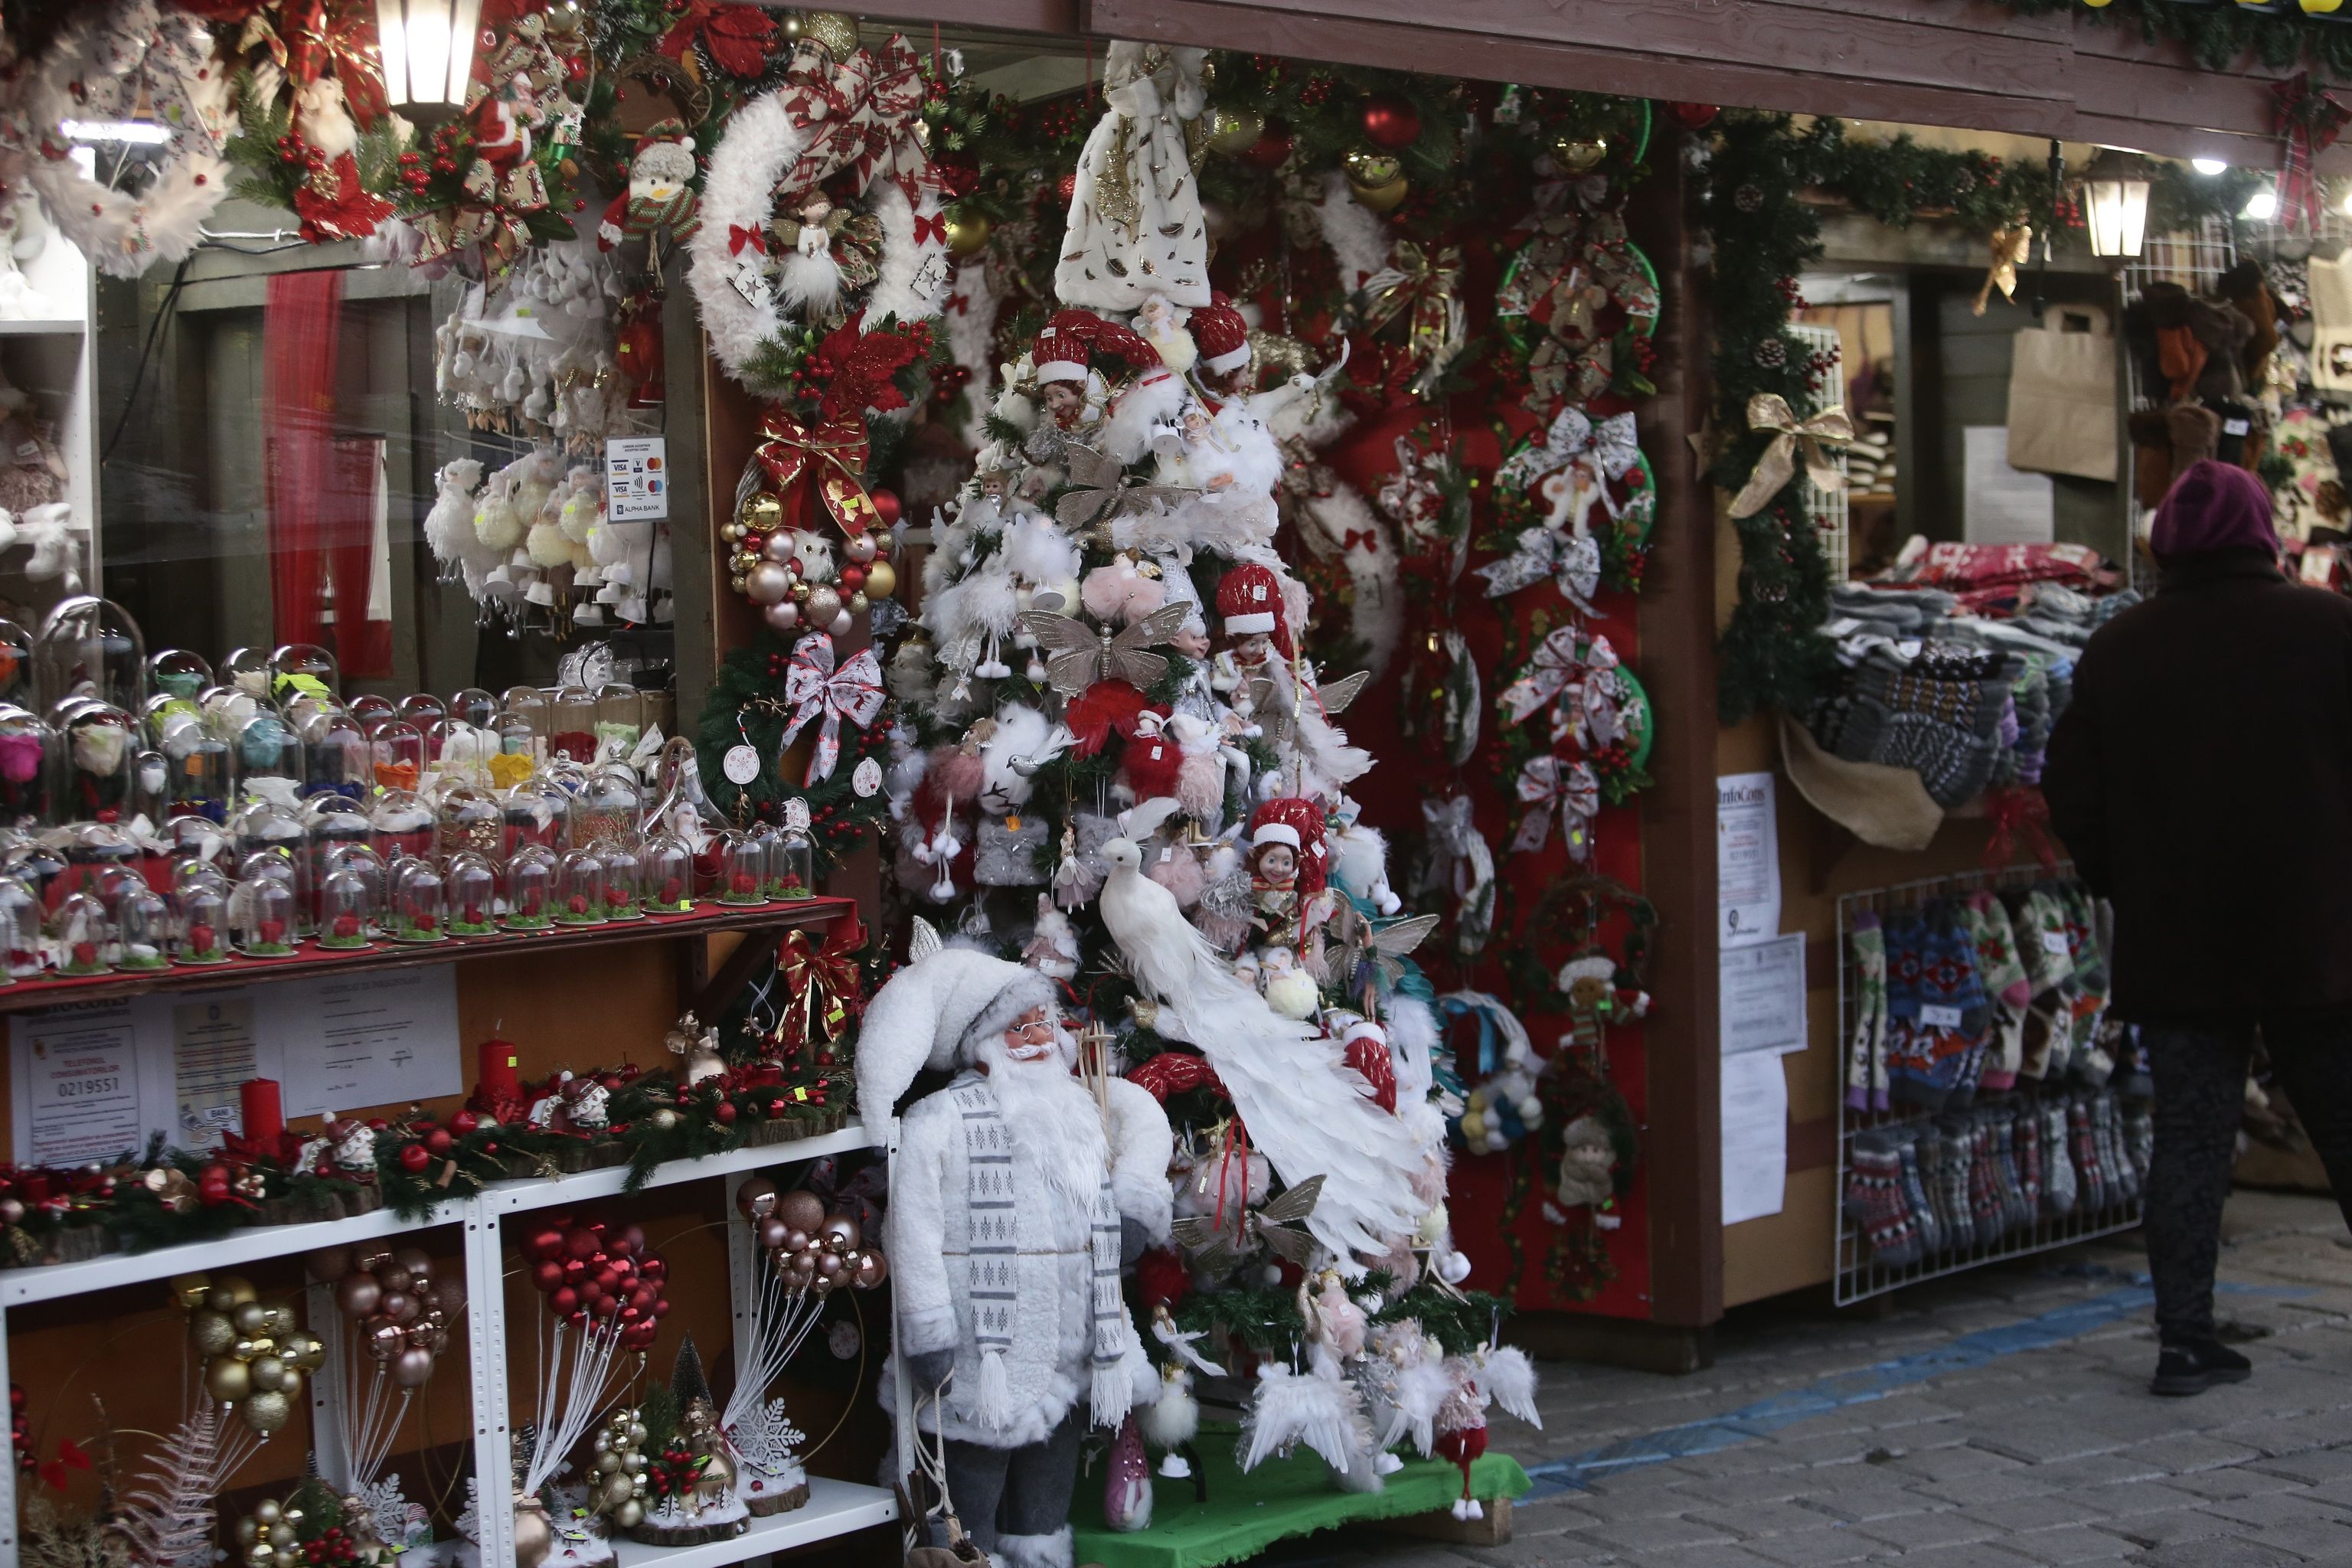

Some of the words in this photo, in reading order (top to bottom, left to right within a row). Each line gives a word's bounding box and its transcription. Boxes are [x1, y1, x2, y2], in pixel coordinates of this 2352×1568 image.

[63, 1057, 106, 1067] TELEFONUL
[60, 1077, 119, 1096] 0219551
[211, 1108, 229, 1117] BANI
